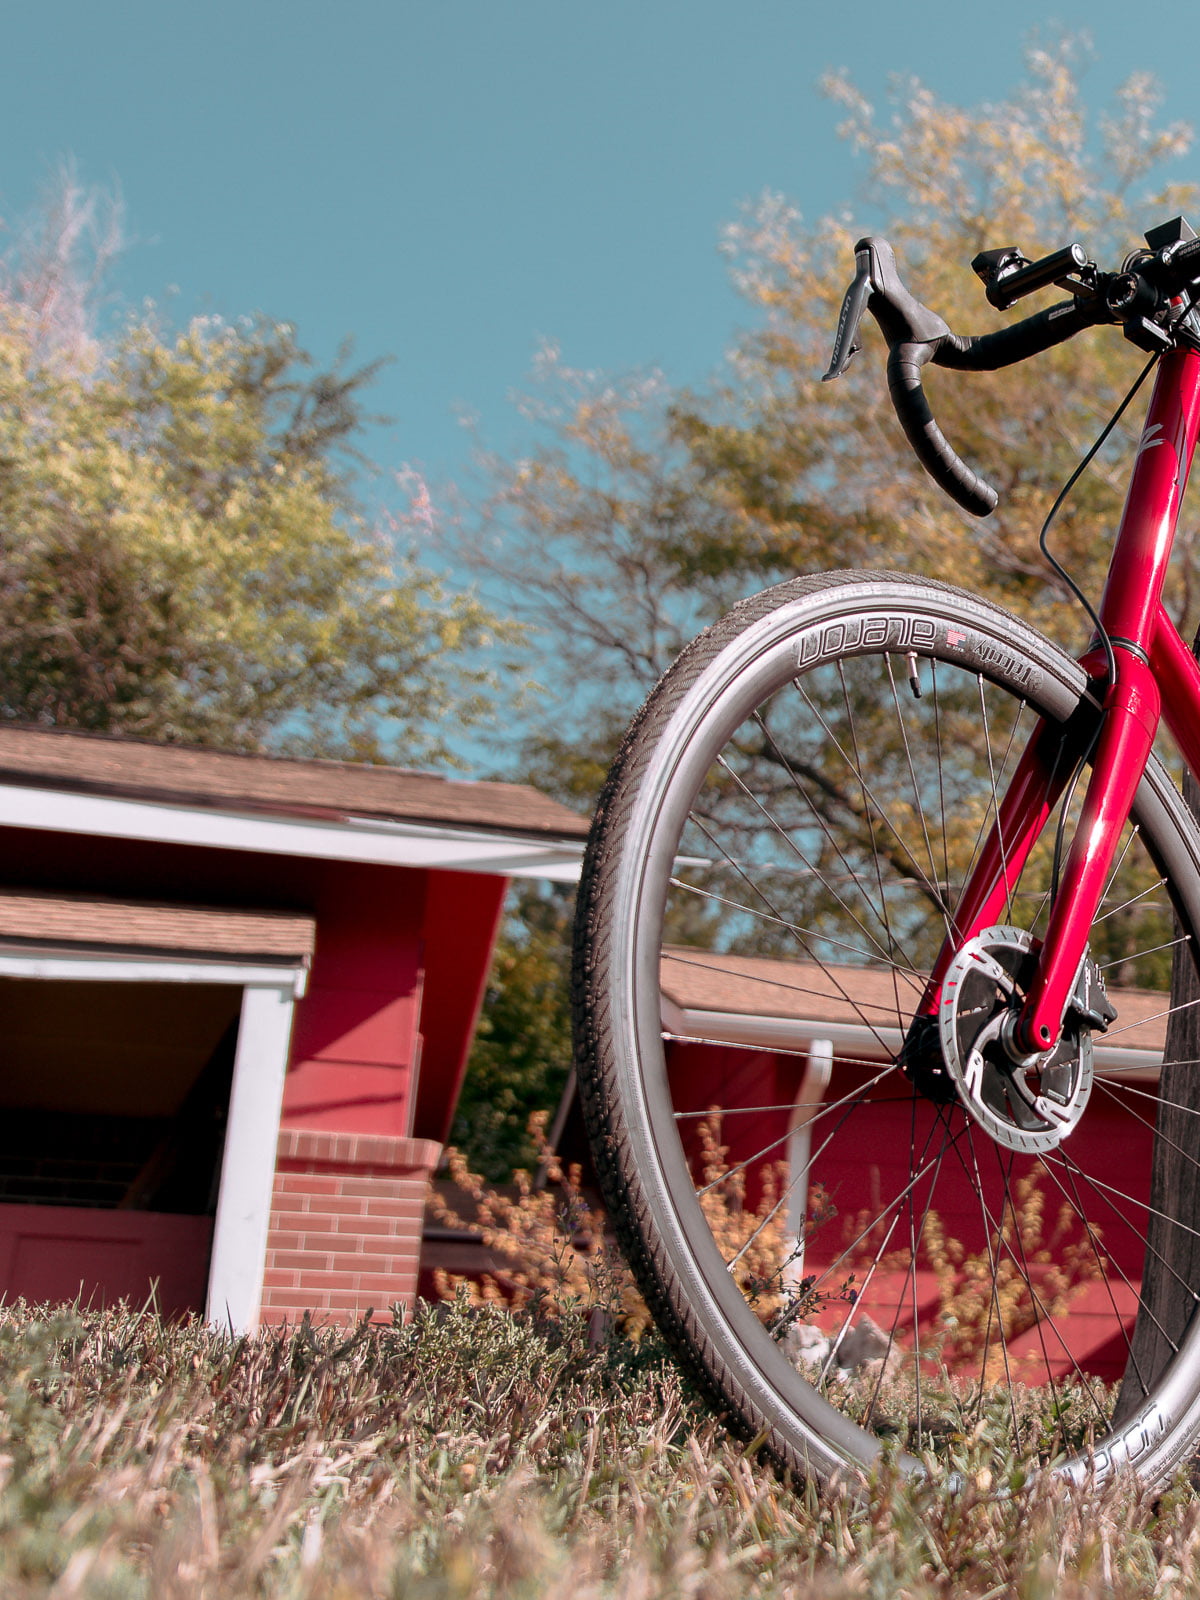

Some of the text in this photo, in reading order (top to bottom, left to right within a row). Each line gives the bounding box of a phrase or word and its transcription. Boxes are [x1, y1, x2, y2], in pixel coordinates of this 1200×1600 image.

[831, 294, 852, 365] ULTEGRA
[801, 584, 883, 608] SCHWALBE
[910, 586, 987, 617] MARATHON
[796, 616, 938, 669] aileron
